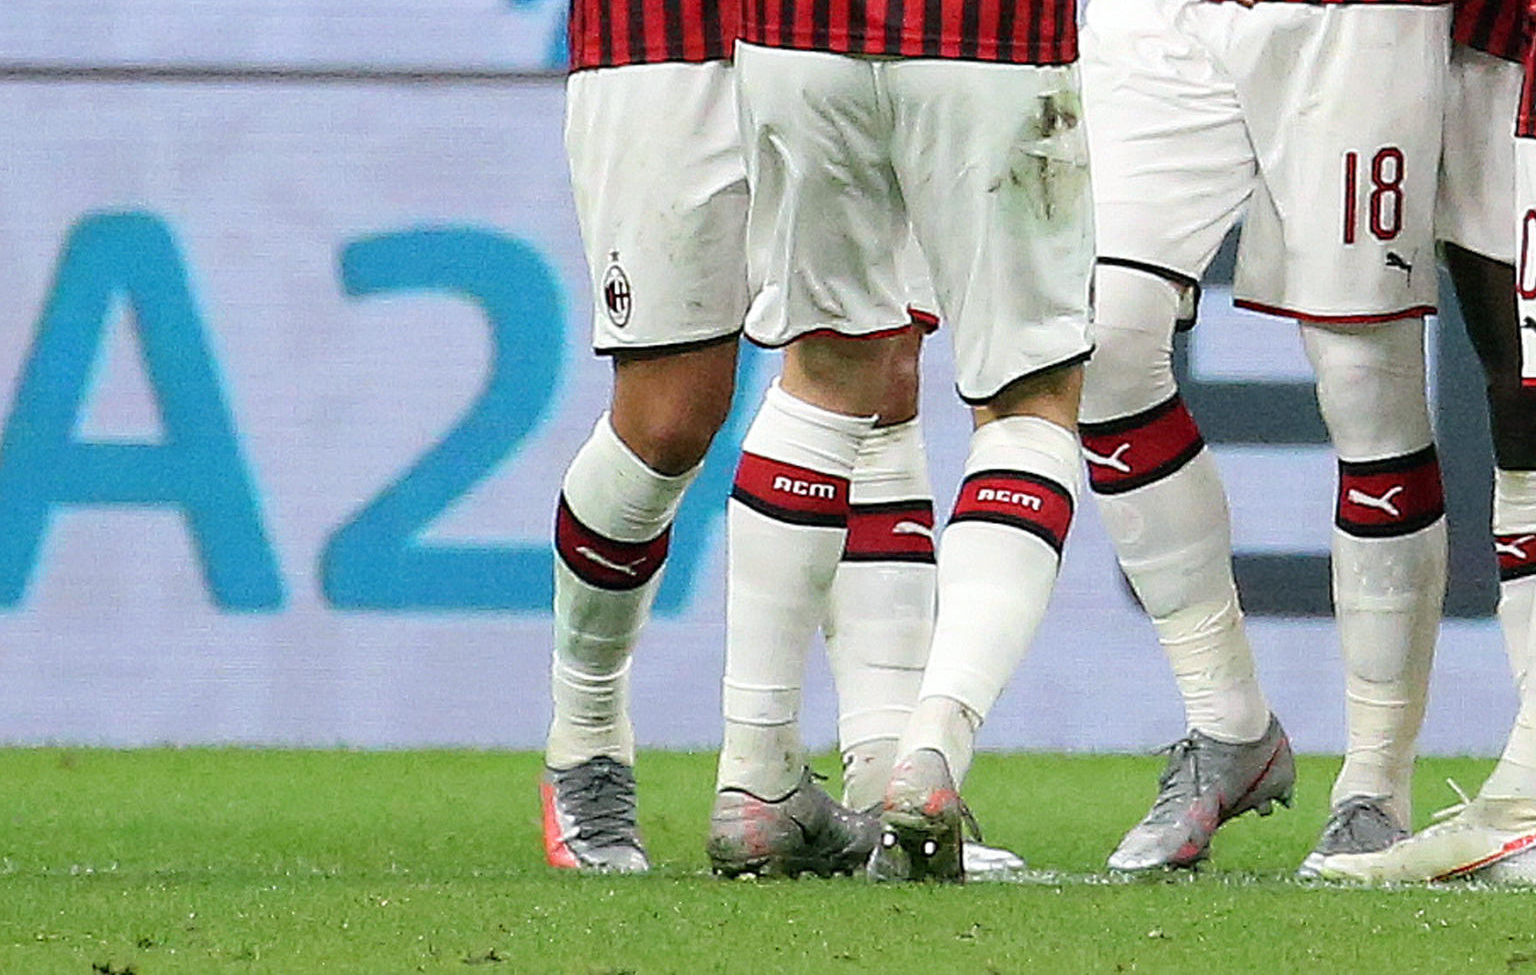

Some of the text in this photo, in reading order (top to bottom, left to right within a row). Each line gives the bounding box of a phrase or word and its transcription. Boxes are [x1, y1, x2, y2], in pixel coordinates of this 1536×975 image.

[1343, 146, 1404, 244] 18
[0, 210, 772, 614] A2
[773, 476, 836, 500] ACM
[976, 488, 1042, 512] ACM
